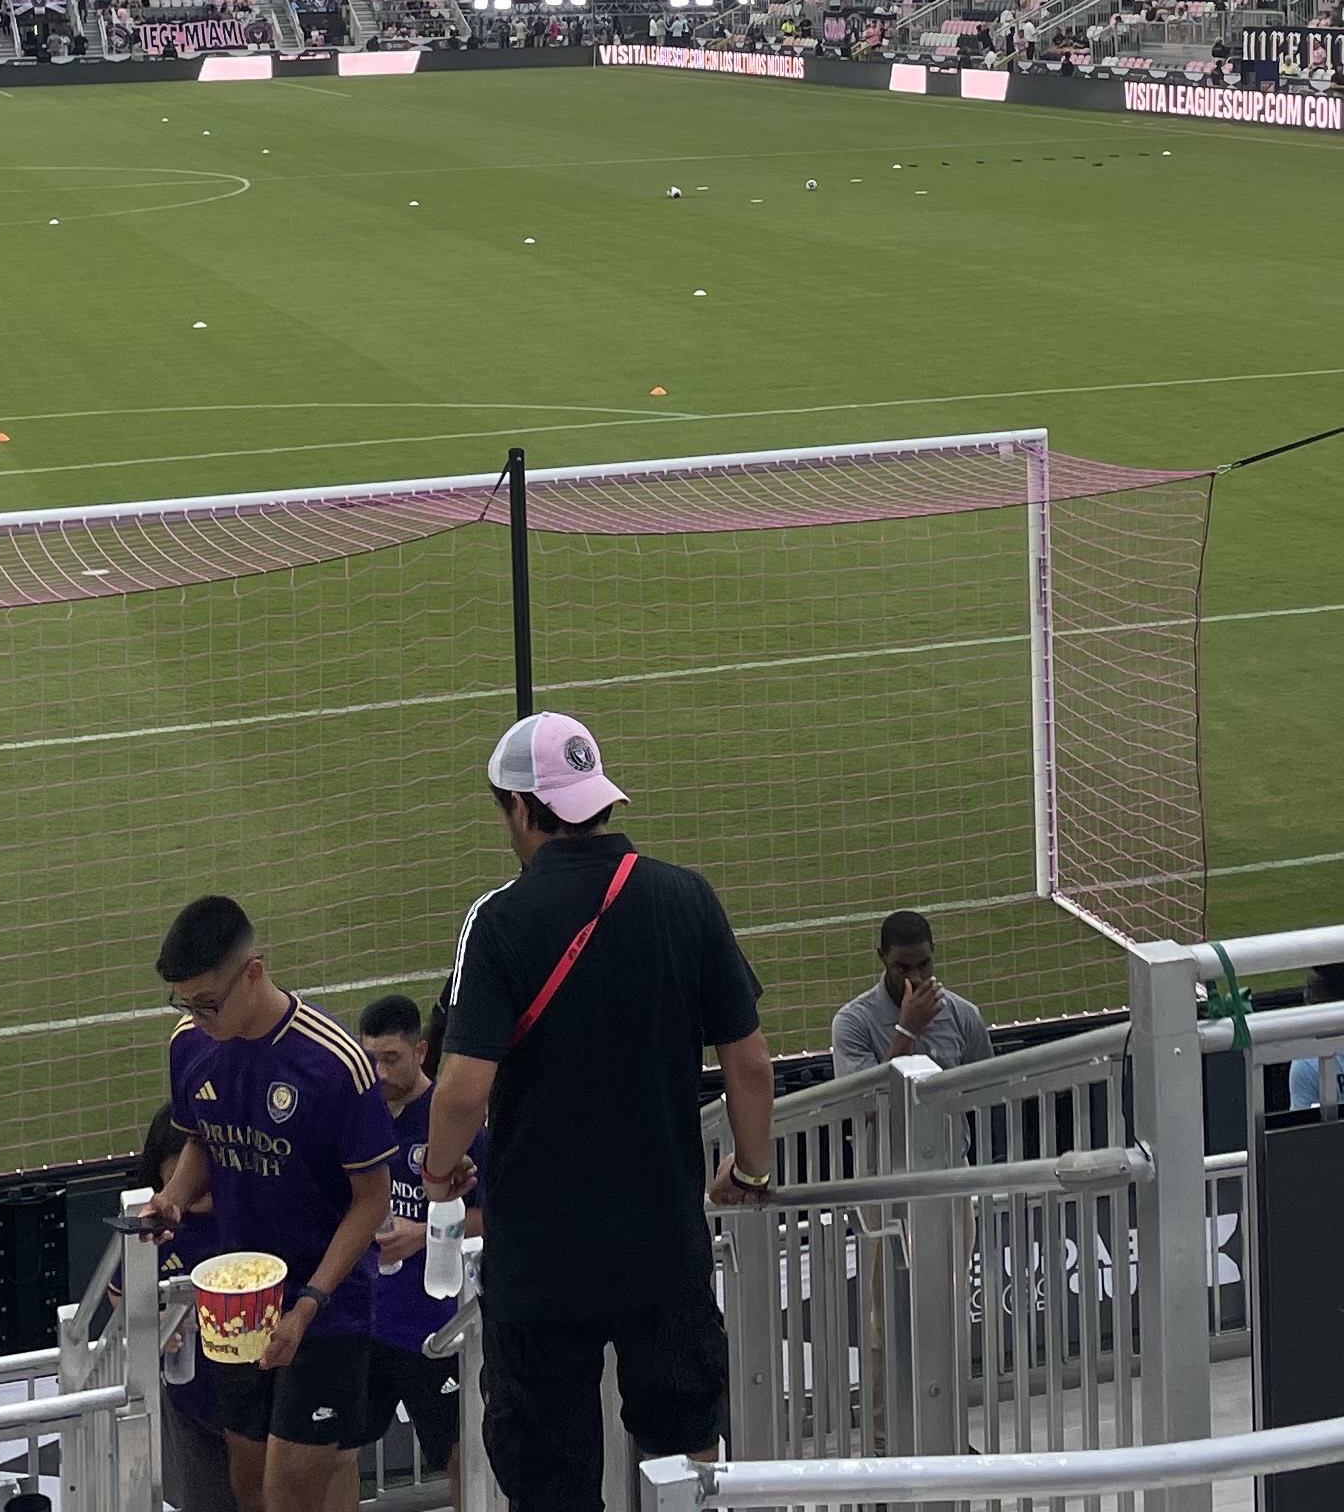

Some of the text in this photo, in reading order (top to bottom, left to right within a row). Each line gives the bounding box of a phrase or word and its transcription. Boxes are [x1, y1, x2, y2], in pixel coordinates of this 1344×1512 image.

[182, 19, 246, 50] MIAMI
[599, 44, 646, 65] VISITA
[704, 50, 720, 71] CON
[719, 50, 733, 72] LOS
[733, 51, 767, 76] ULTIMOS
[766, 54, 805, 79] MODELOS
[1123, 81, 1167, 113] VISITA
[1168, 85, 1302, 126] LEAGUESCUP.COM
[1304, 95, 1342, 130] CON
